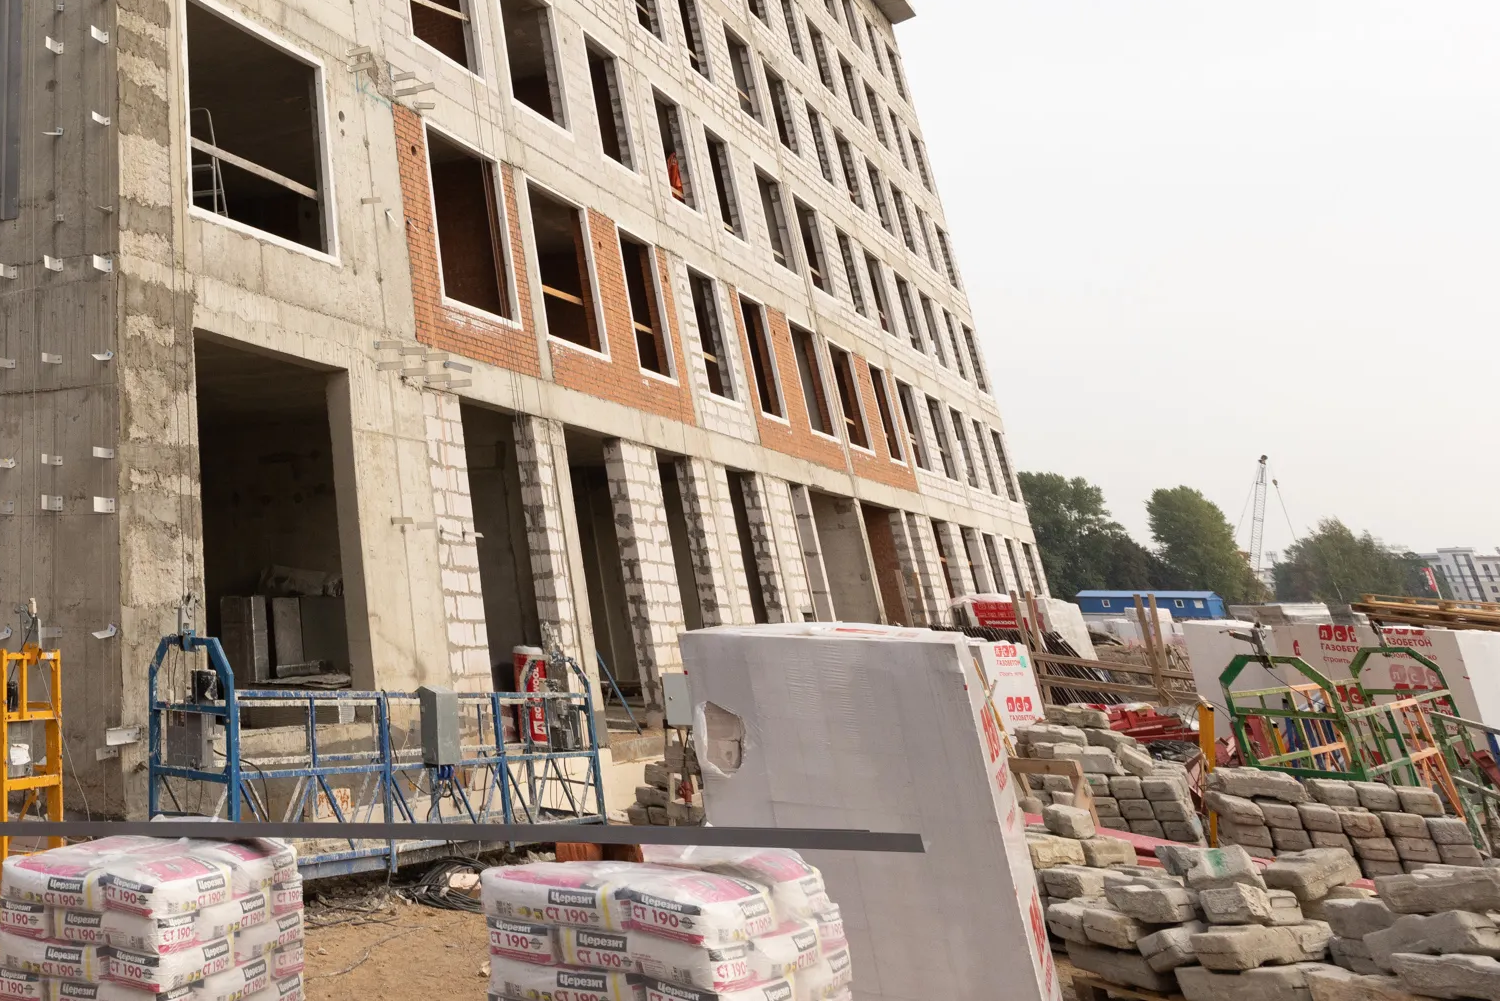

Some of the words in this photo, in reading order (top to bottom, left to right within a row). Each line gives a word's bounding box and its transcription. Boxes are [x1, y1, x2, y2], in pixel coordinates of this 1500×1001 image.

[533, 667, 542, 719] ROWOOL
[50, 878, 81, 891] Церезит
[114, 877, 142, 891] Церезит
[57, 895, 76, 906] 190
[119, 889, 137, 904] 190
[209, 892, 221, 903] 190
[551, 891, 593, 905] Церезит
[641, 894, 683, 911] Церезит
[5, 901, 32, 912] Церезит
[12, 912, 28, 925] 190
[67, 912, 100, 925] Церезит
[250, 913, 261, 925] 190
[564, 909, 588, 923] 190
[652, 909, 680, 928] 190
[496, 919, 532, 933] Церезит
[78, 929, 96, 941] 190
[177, 927, 191, 940] 190
[505, 933, 529, 949] 190
[579, 933, 624, 948] Церезит
[48, 948, 80, 961] Церезит
[116, 950, 146, 964] Церезит
[596, 952, 622, 967] 190
[56, 965, 75, 977] 190
[123, 964, 142, 979] 190
[212, 961, 225, 973] 190
[732, 961, 746, 977] 190
[1, 968, 27, 980] Церезит
[7, 981, 24, 994] 190
[252, 980, 262, 992] 190
[559, 974, 604, 988] Церезит
[62, 983, 95, 996] Церезит
